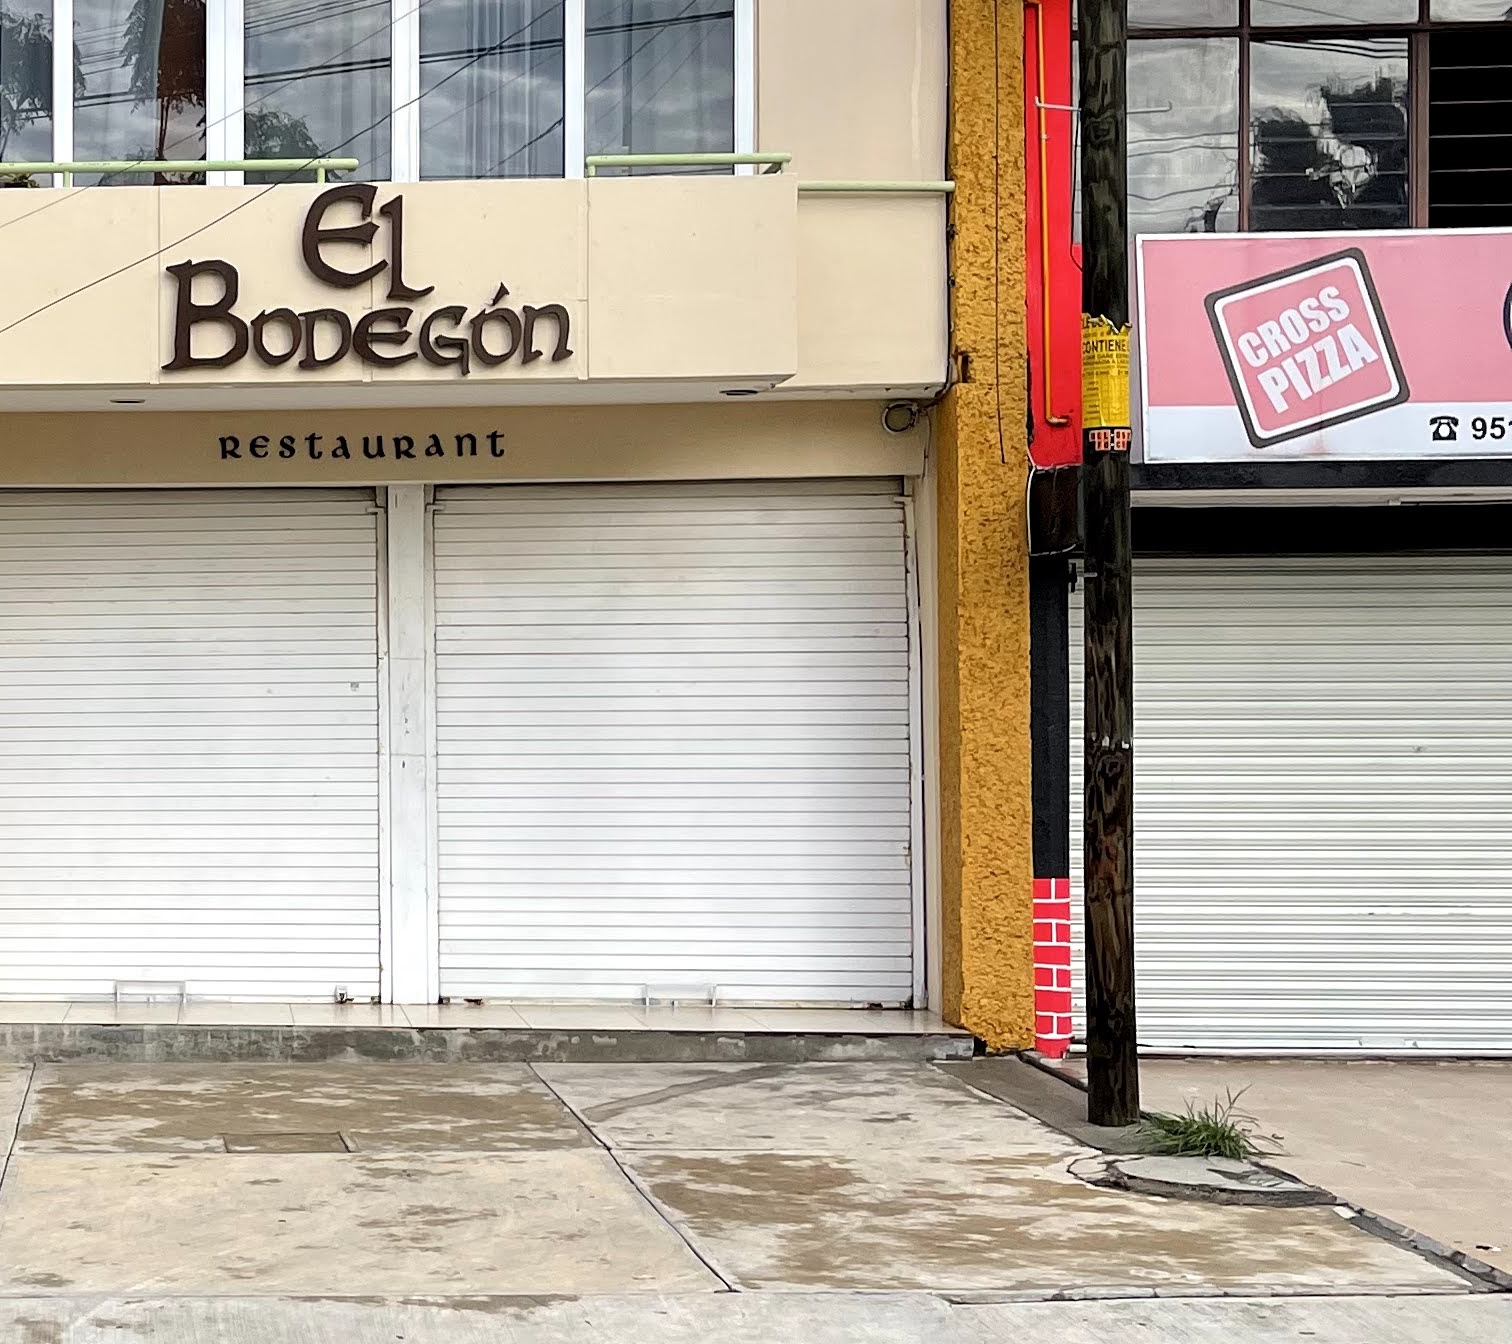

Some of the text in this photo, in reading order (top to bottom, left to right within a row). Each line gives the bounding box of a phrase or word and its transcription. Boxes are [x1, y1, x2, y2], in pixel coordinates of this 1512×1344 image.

[302, 183, 434, 300] El
[1237, 286, 1351, 368] CROSS
[1257, 323, 1379, 414] PIZZA
